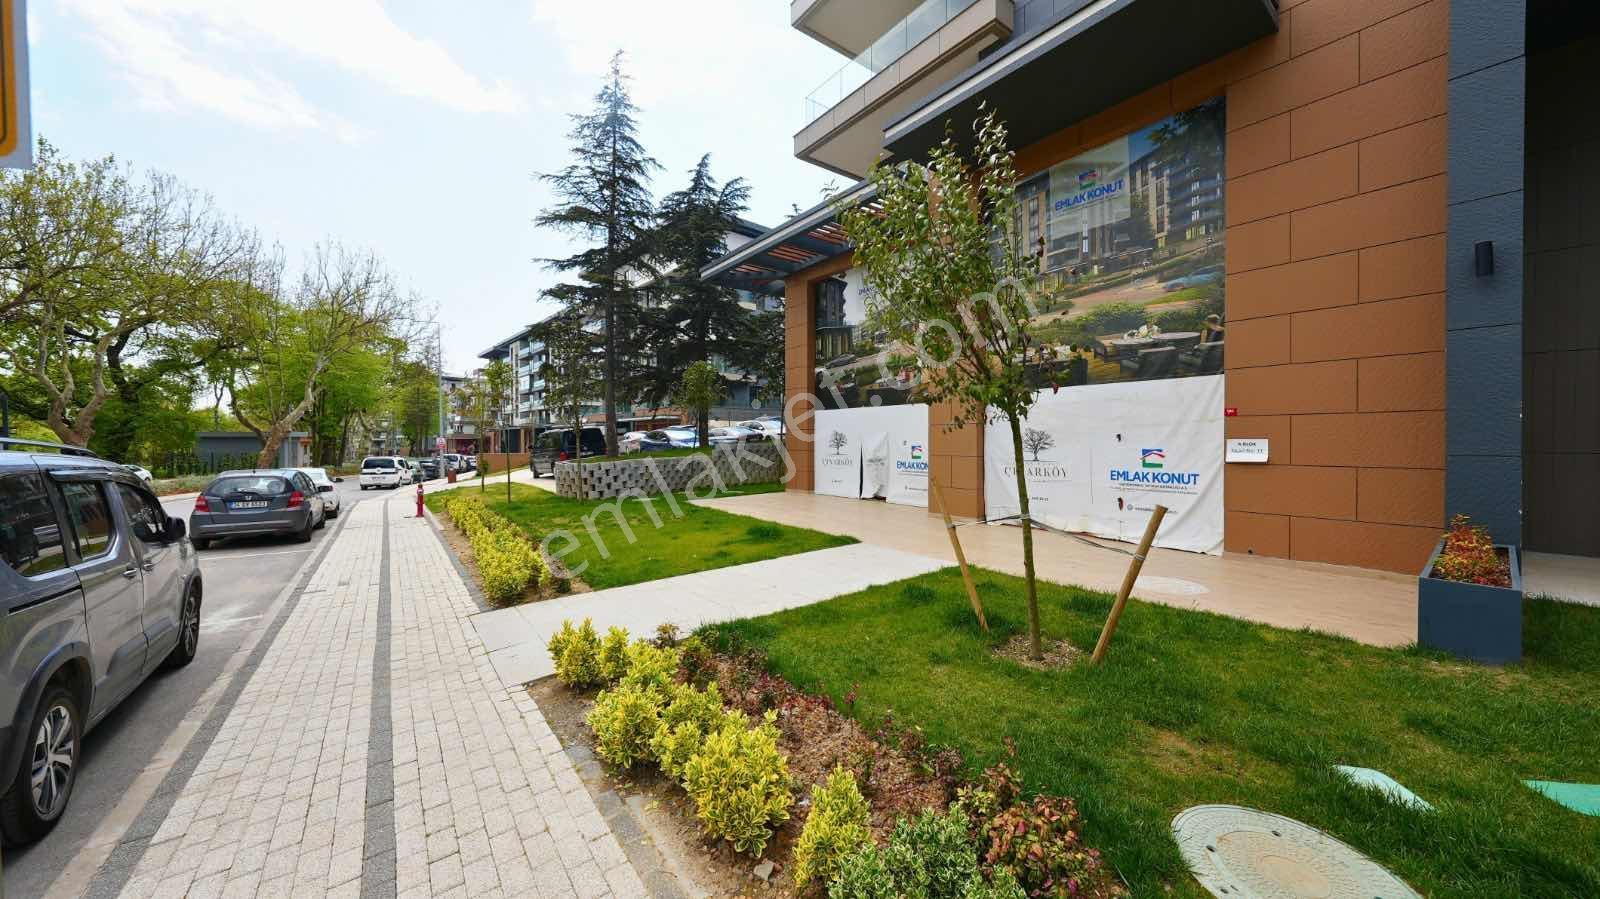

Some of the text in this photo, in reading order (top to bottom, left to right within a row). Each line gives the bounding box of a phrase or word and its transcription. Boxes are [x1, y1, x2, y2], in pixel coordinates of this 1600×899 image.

[1055, 178, 1125, 211] EMLAK KONUT
[896, 460, 929, 471] EMLAK KON
[1004, 464, 1067, 478] ÇIARKÖY
[1110, 469, 1200, 485] EMLAK KONUT
